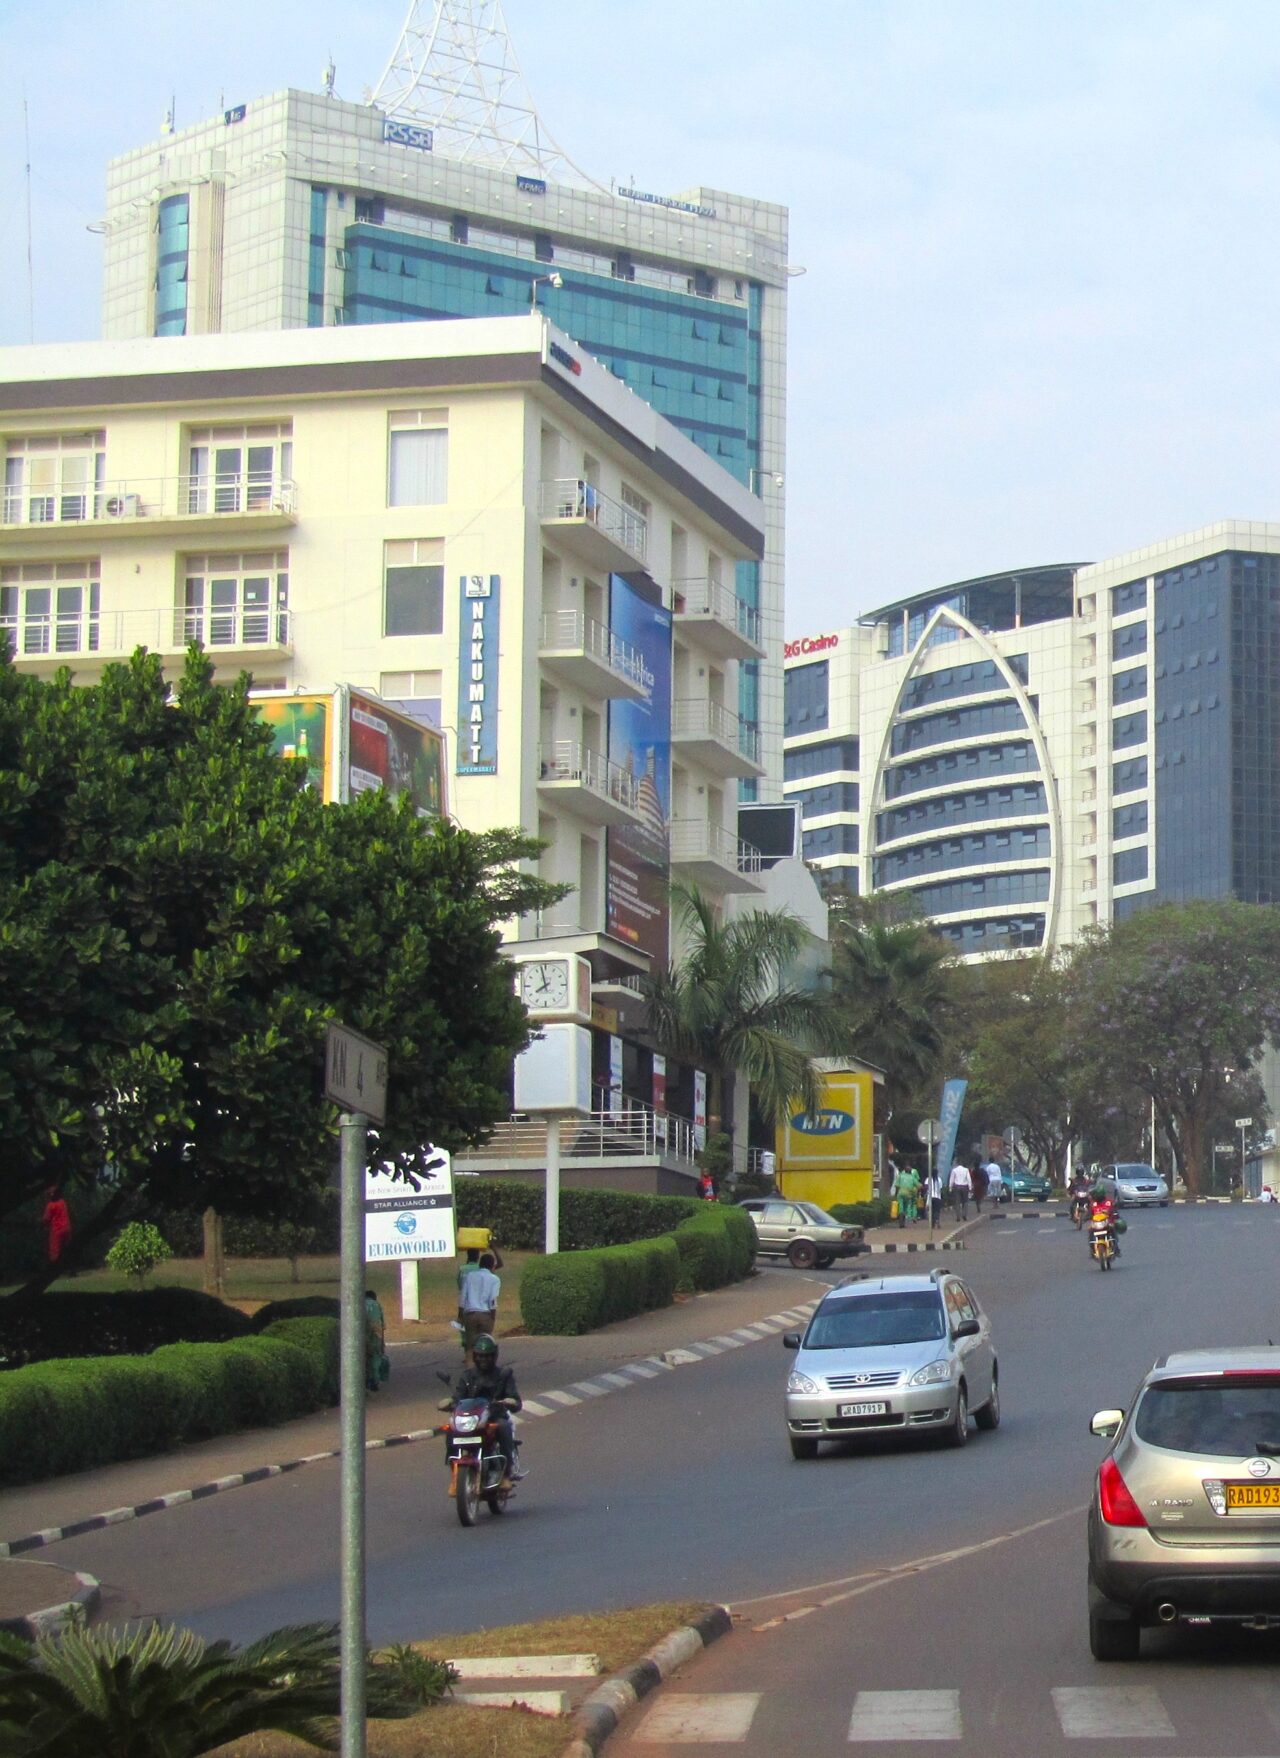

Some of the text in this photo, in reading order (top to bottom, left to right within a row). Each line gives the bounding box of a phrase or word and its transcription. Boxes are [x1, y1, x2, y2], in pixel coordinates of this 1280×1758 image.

[384, 121, 432, 149] RSSB
[801, 634, 838, 655] Casino
[469, 602, 485, 764] NAKUMATT
[393, 1200, 428, 1208] ALLIANCE
[368, 1240, 447, 1257] EUROWORLD
